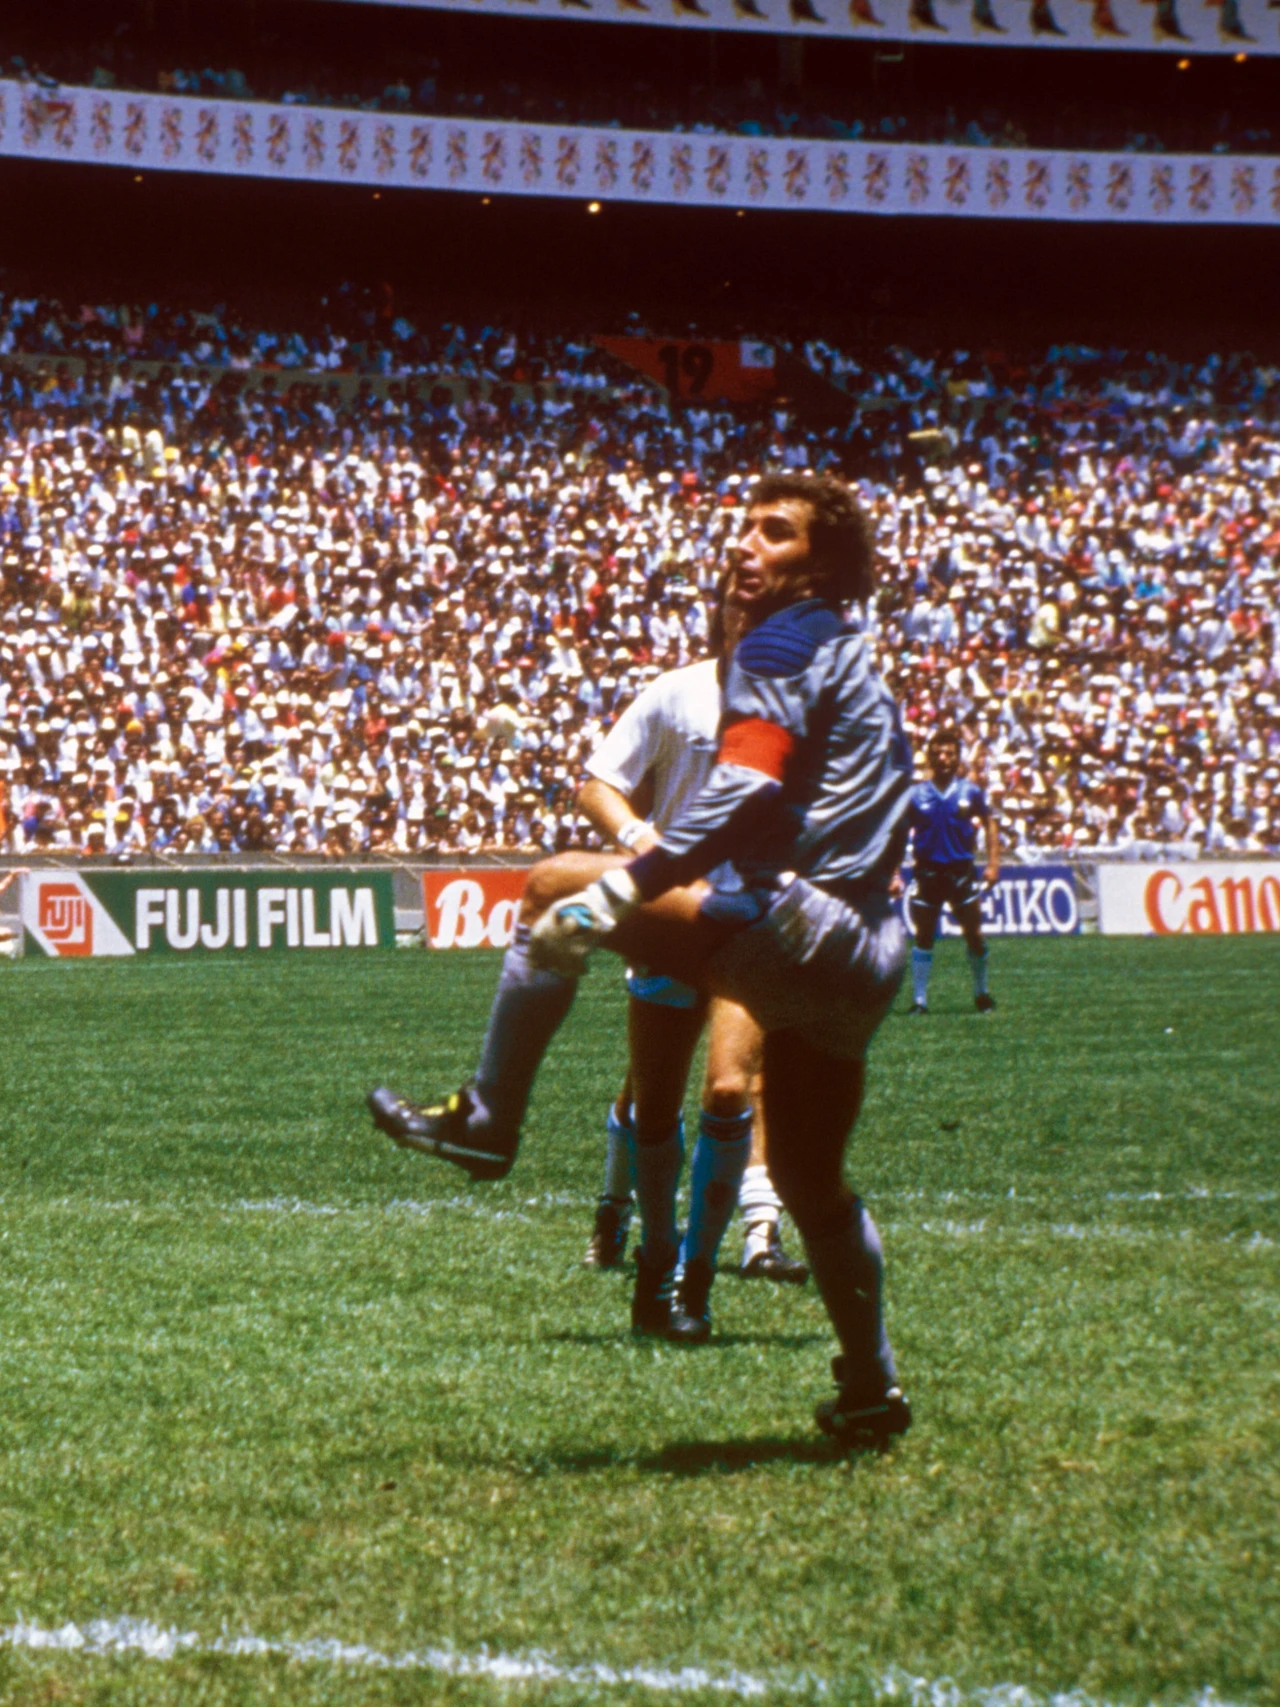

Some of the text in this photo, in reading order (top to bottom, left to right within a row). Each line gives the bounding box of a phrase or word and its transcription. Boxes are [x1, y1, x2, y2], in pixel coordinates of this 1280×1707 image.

[658, 345, 714, 396] 19
[431, 879, 521, 948] Ba
[1144, 868, 1280, 934] Cano
